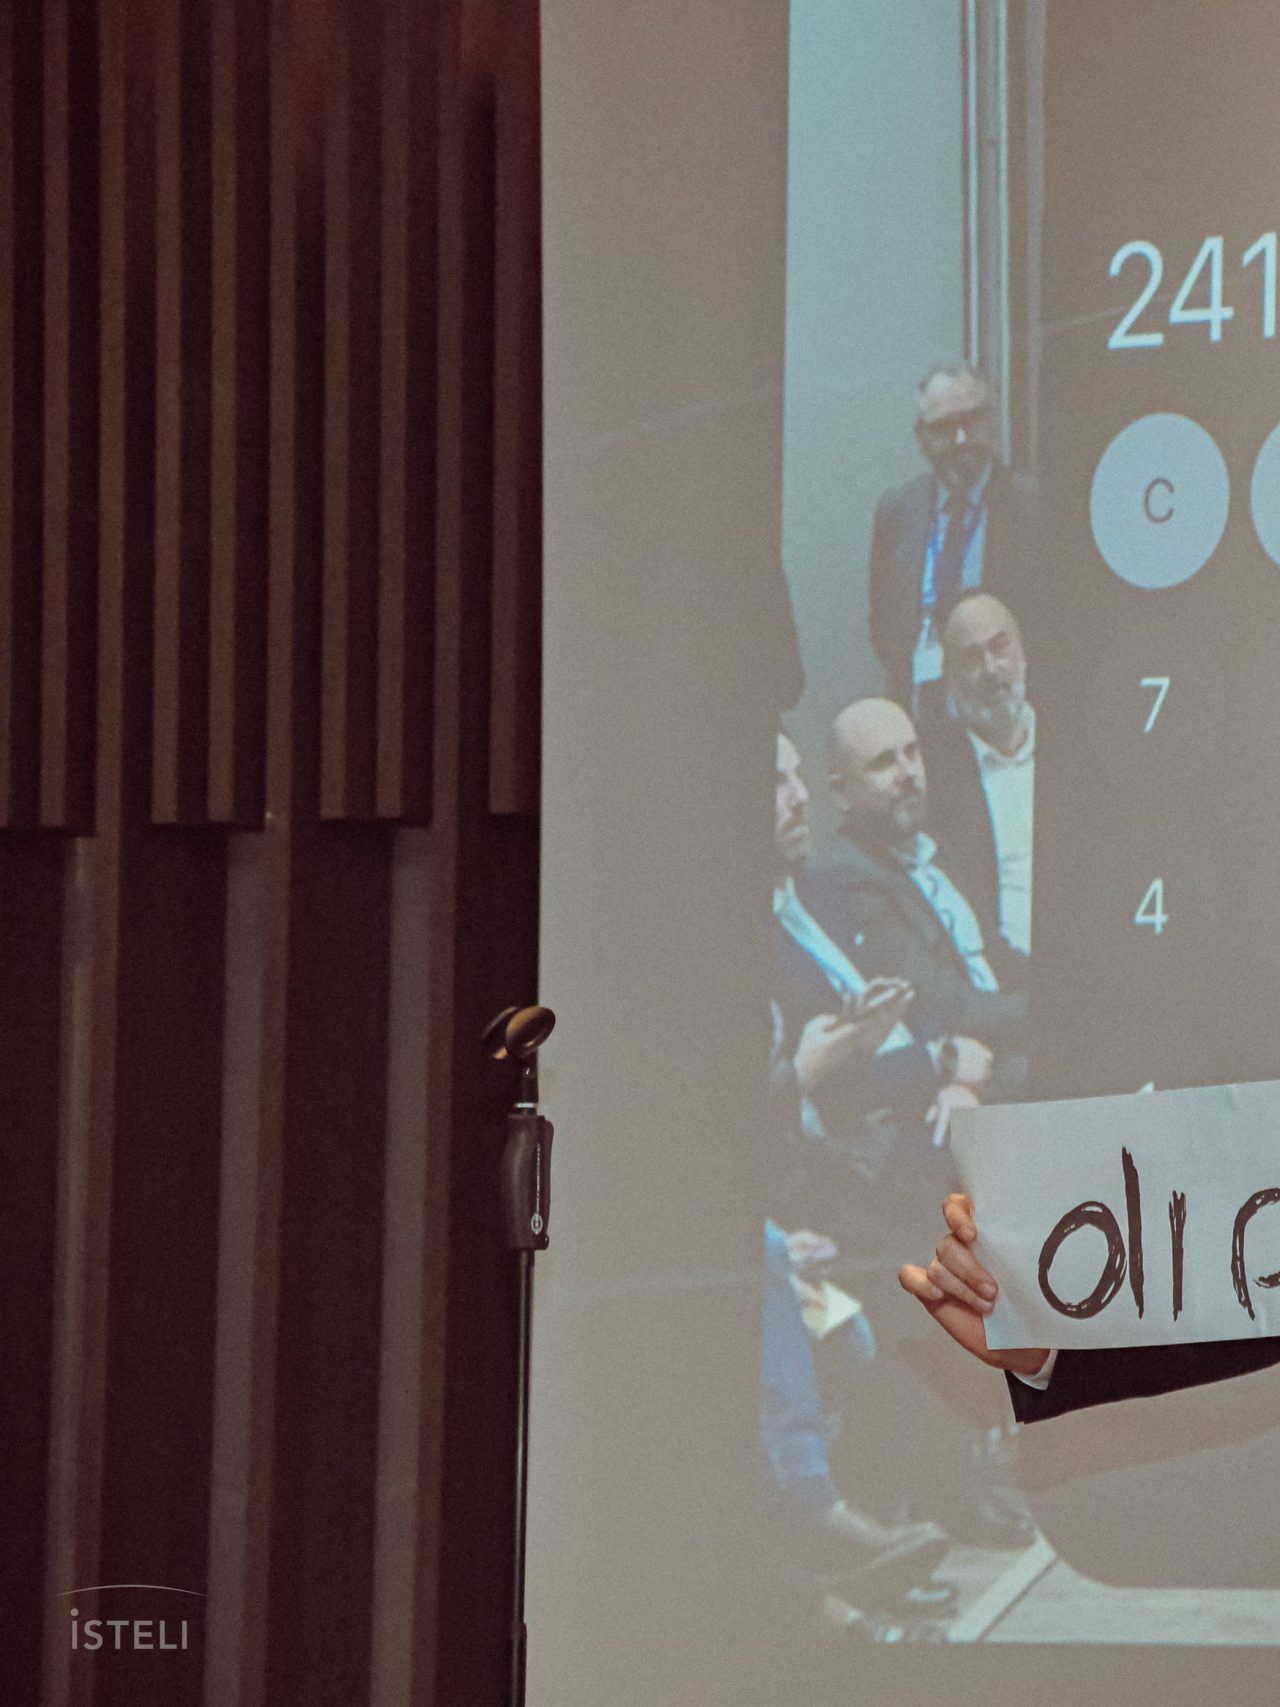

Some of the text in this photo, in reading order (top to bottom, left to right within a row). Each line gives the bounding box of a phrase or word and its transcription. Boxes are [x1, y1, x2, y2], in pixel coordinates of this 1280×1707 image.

[1143, 477, 1176, 524] C
[1138, 676, 1171, 733] 7
[1134, 878, 1169, 935] 4
